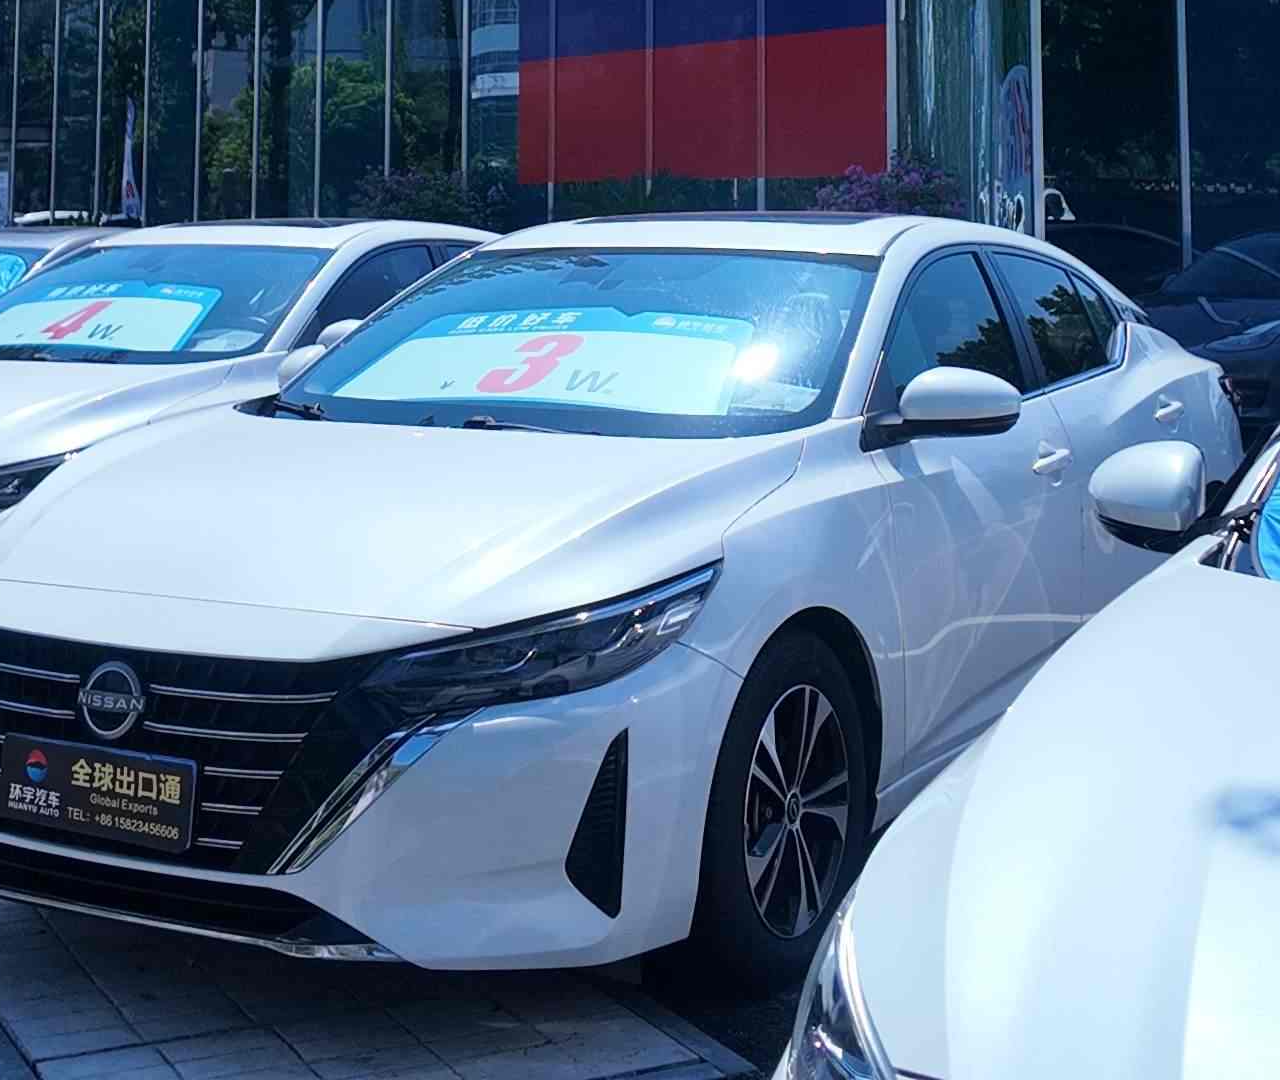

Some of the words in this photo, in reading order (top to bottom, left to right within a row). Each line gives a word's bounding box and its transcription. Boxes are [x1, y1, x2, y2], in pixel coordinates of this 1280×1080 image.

[40, 300, 113, 340] 4
[88, 323, 124, 340] W
[475, 334, 585, 393] 3
[565, 369, 619, 393] W
[77, 690, 146, 712] NISSAN
[70, 757, 182, 806] 全球出口通
[8, 782, 62, 809] 环宇汽车
[89, 792, 120, 810] Global
[121, 797, 159, 817] Exports
[39, 805, 61, 818] AUTO
[67, 806, 91, 823] TEL:
